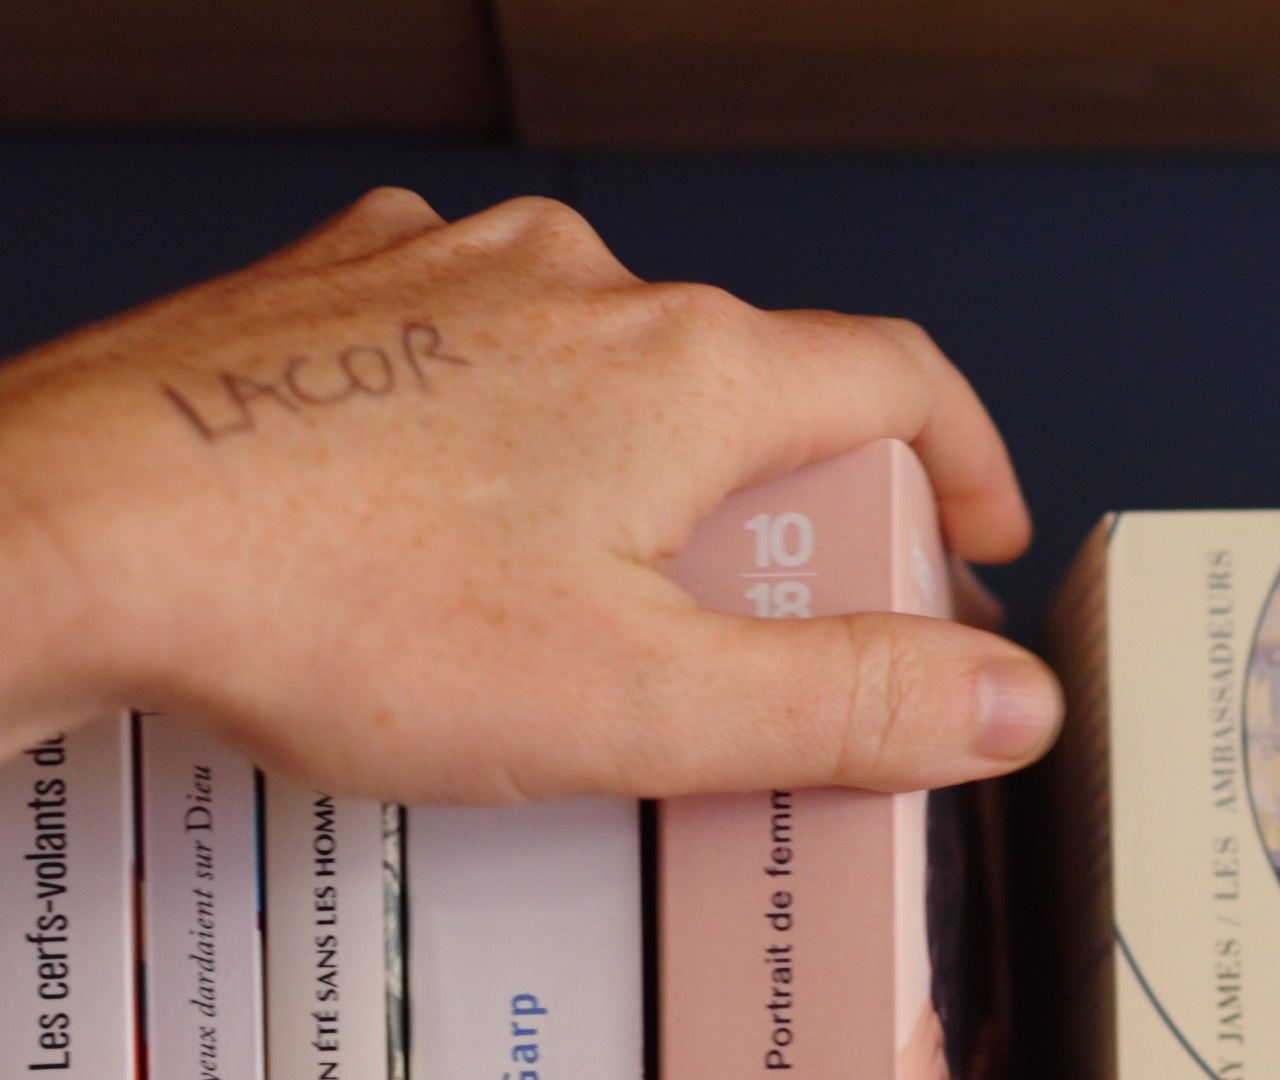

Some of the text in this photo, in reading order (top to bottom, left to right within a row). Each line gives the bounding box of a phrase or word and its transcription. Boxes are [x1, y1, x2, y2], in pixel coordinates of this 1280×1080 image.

[161, 320, 472, 443] LACOR
[745, 512, 815, 568] 10
[1207, 547, 1238, 814] AMBASSADEURS
[184, 764, 212, 832] Dieu
[23, 777, 70, 1000] cerfs-volants
[196, 839, 214, 880] sur
[1214, 836, 1240, 901] LES
[315, 885, 337, 925] LES
[764, 890, 793, 933] de
[189, 887, 217, 1018] dardaient
[316, 934, 338, 1001] SANS
[765, 944, 794, 1070] Portrait
[1216, 940, 1244, 1046] JAMES
[28, 1012, 70, 1070] Les
[311, 1010, 340, 1052] ÉTÉ
